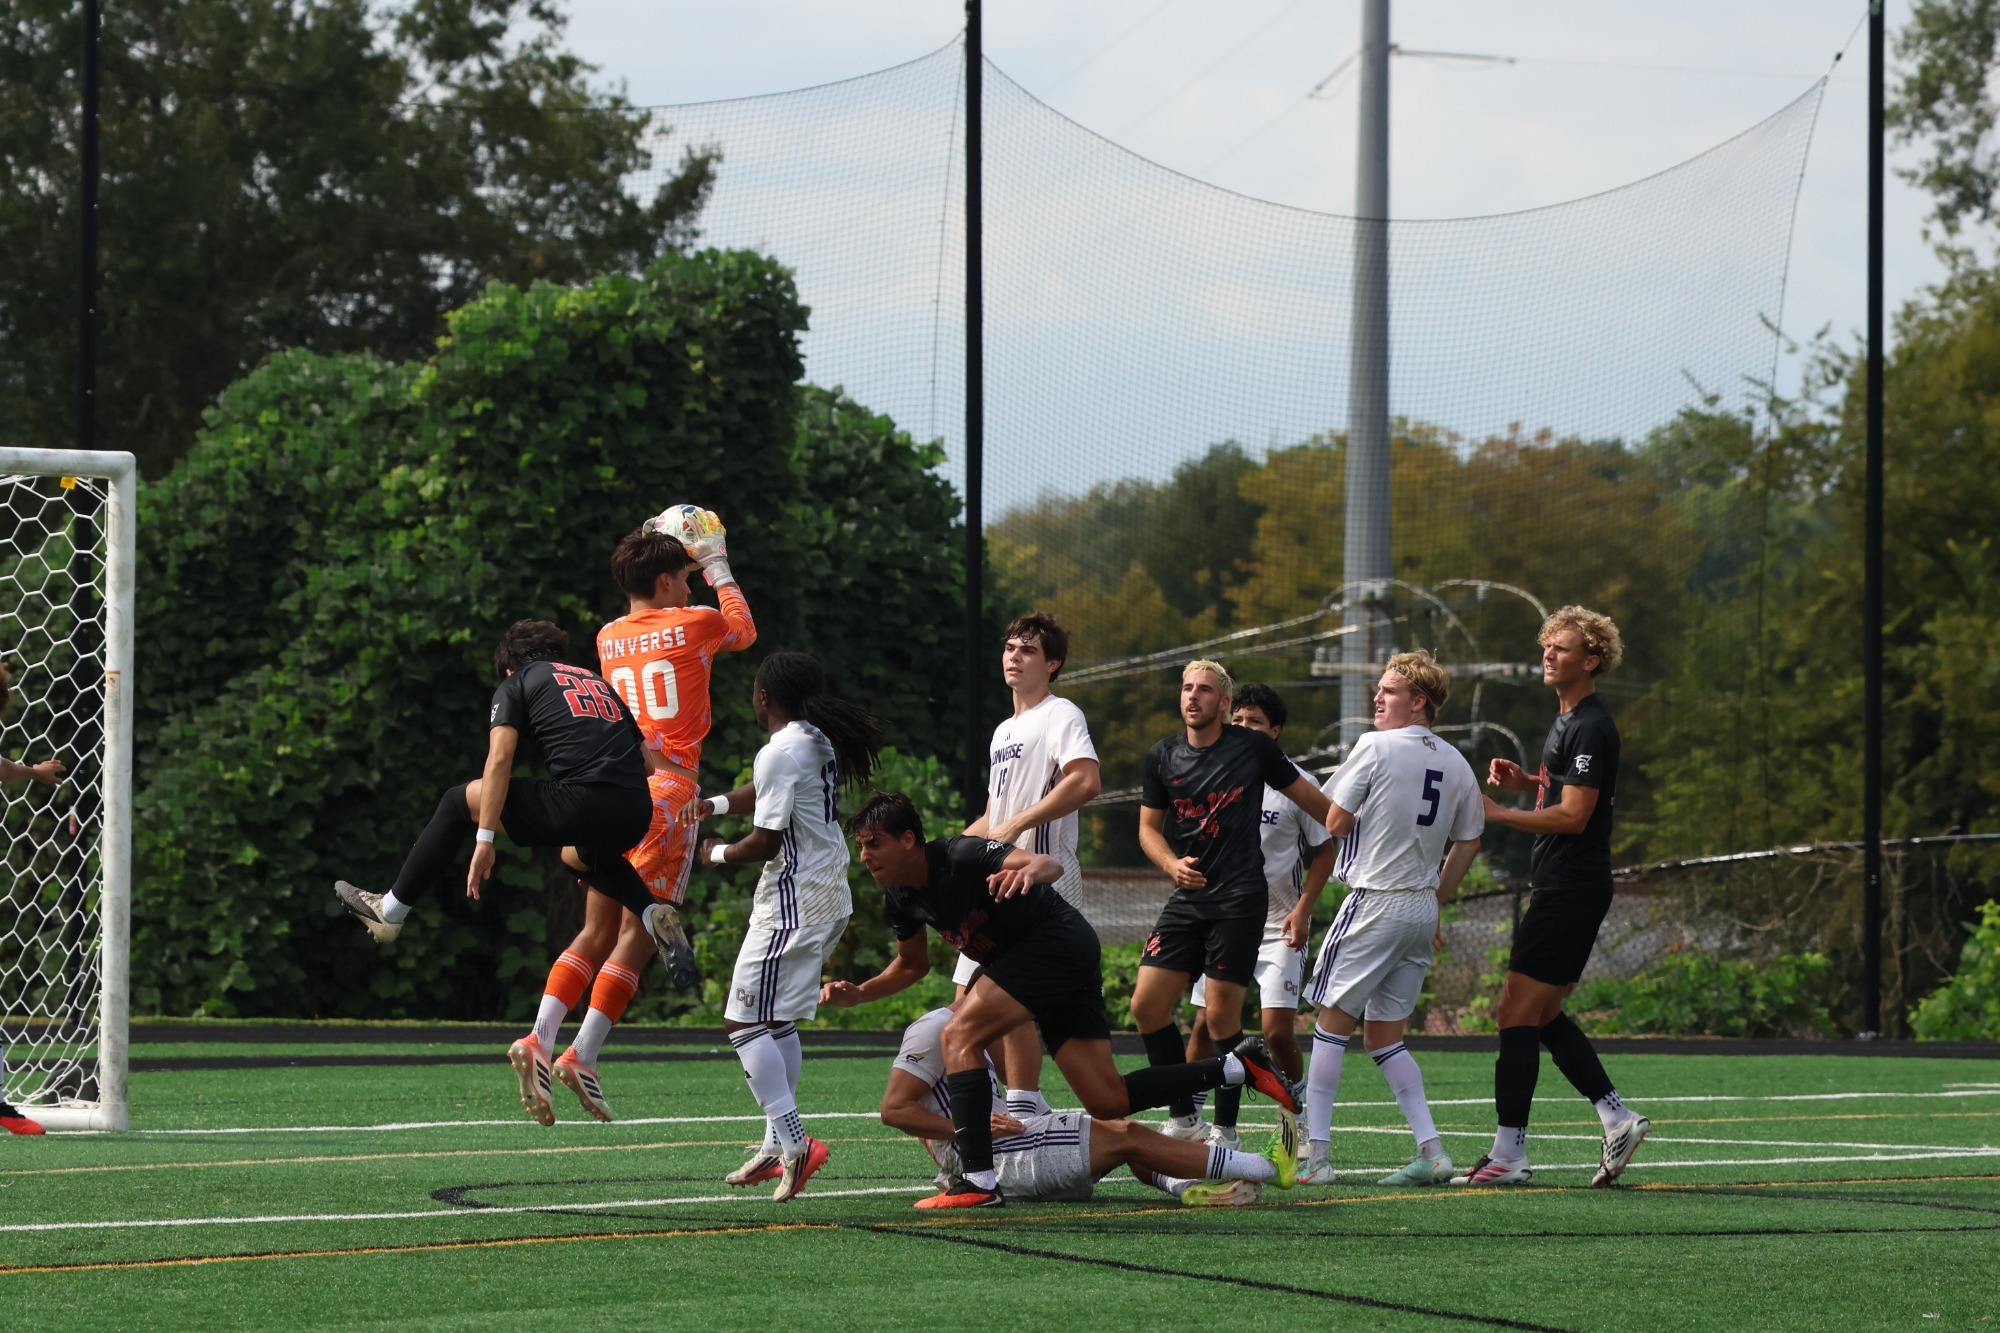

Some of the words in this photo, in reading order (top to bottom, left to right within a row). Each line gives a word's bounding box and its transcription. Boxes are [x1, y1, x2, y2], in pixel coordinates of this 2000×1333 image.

[552, 672, 623, 722] 26
[611, 659, 680, 721] 00
[1416, 768, 1443, 827] 5
[736, 988, 755, 1008] CU
